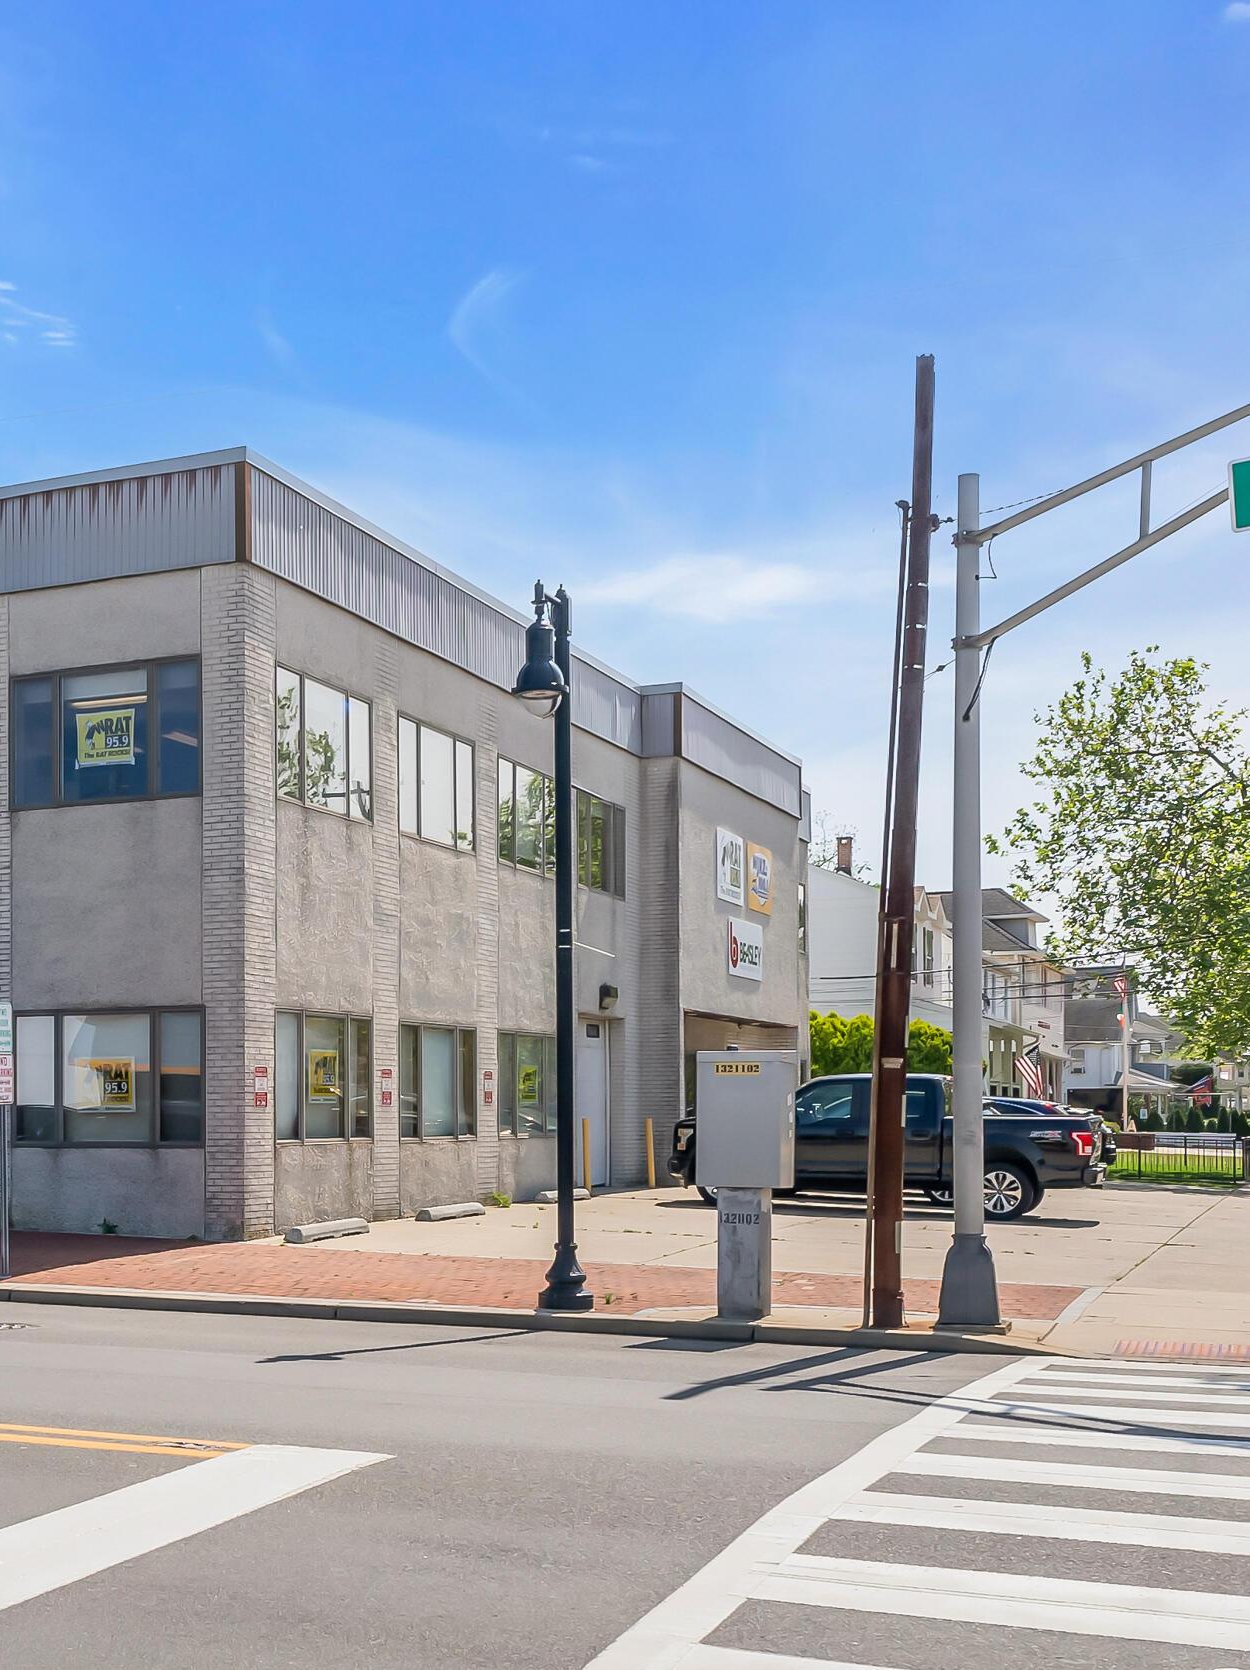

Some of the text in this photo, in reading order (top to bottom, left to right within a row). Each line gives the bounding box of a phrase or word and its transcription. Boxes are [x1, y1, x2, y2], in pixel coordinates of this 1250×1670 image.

[106, 736, 129, 748] 95.9
[715, 1064, 760, 1073] 1321102
[105, 1081, 128, 1094] 95.9
